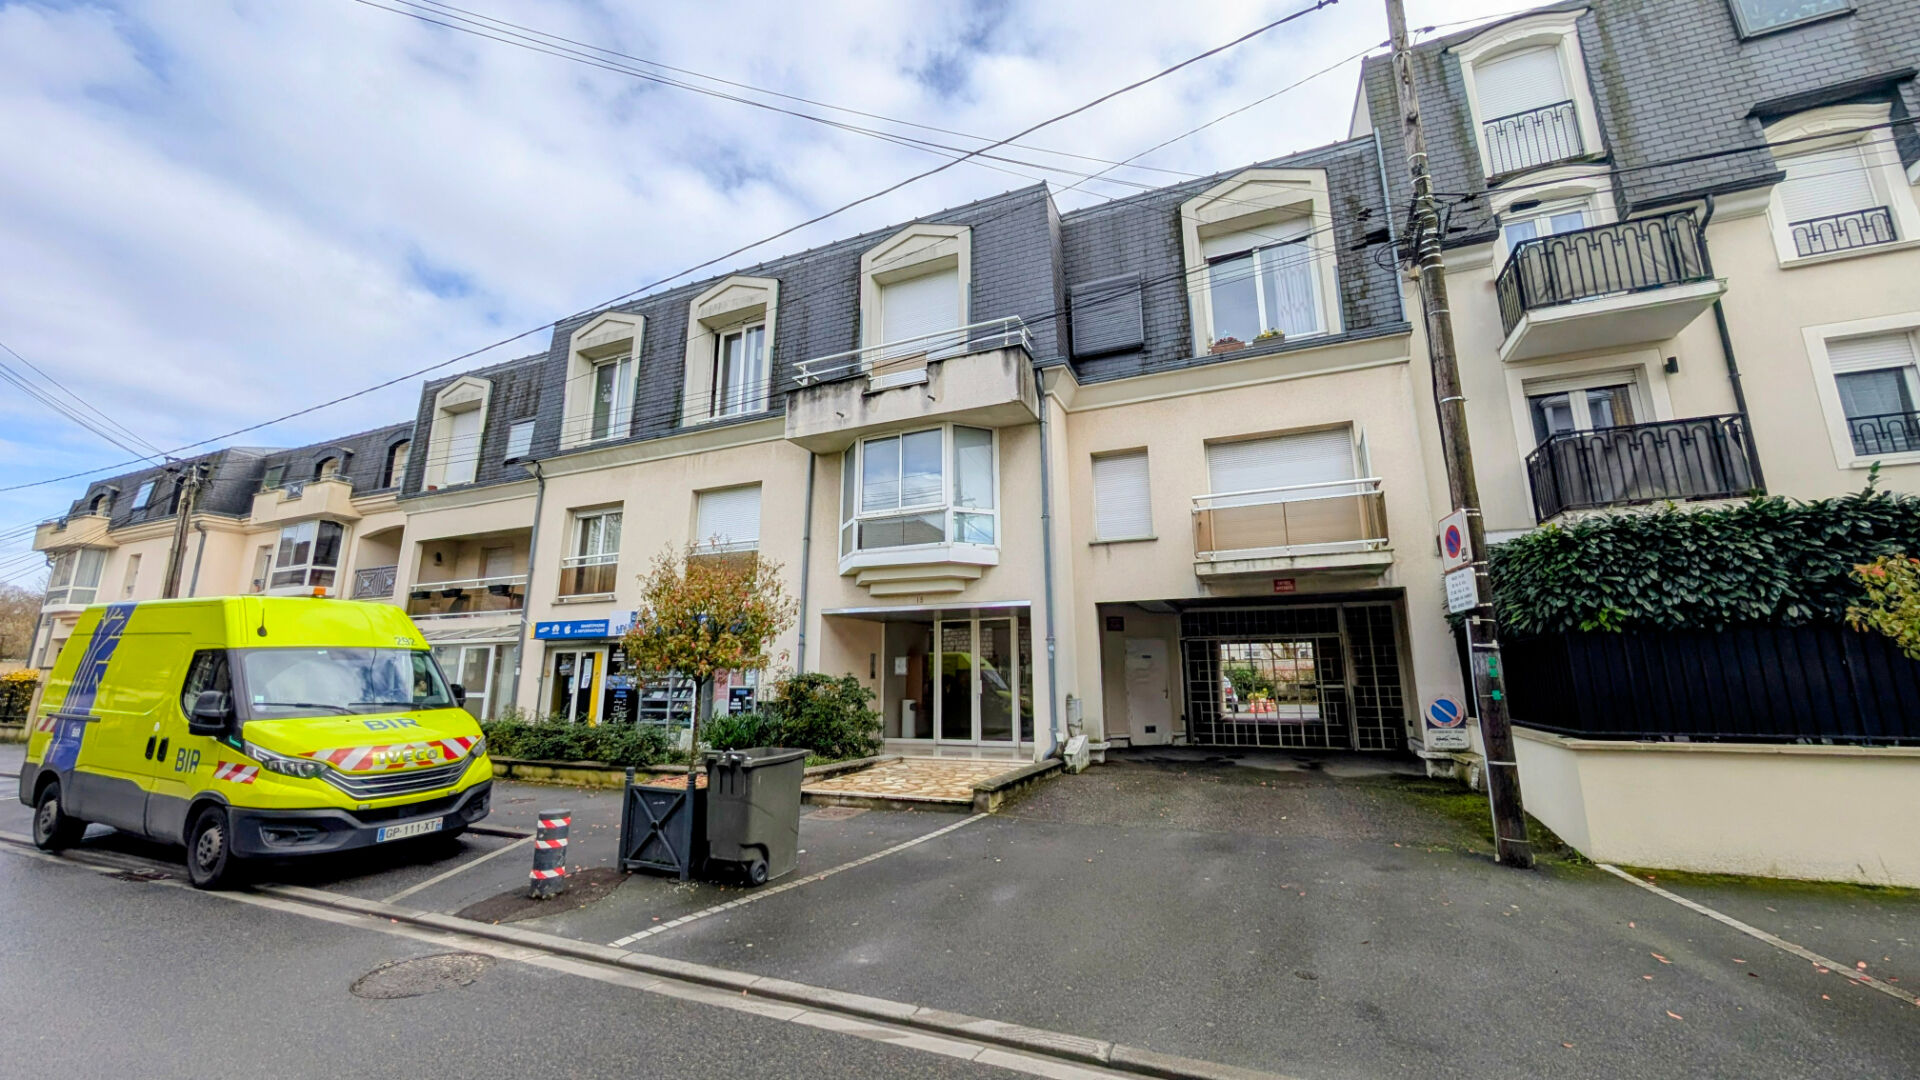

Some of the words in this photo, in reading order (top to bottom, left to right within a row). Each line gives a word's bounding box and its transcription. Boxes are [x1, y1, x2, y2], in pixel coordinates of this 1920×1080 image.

[394, 636, 418, 646] 292
[363, 718, 421, 731] BIR
[175, 747, 201, 774] BIR
[378, 748, 438, 765] IVECO
[386, 820, 436, 839] GP-111-XT
